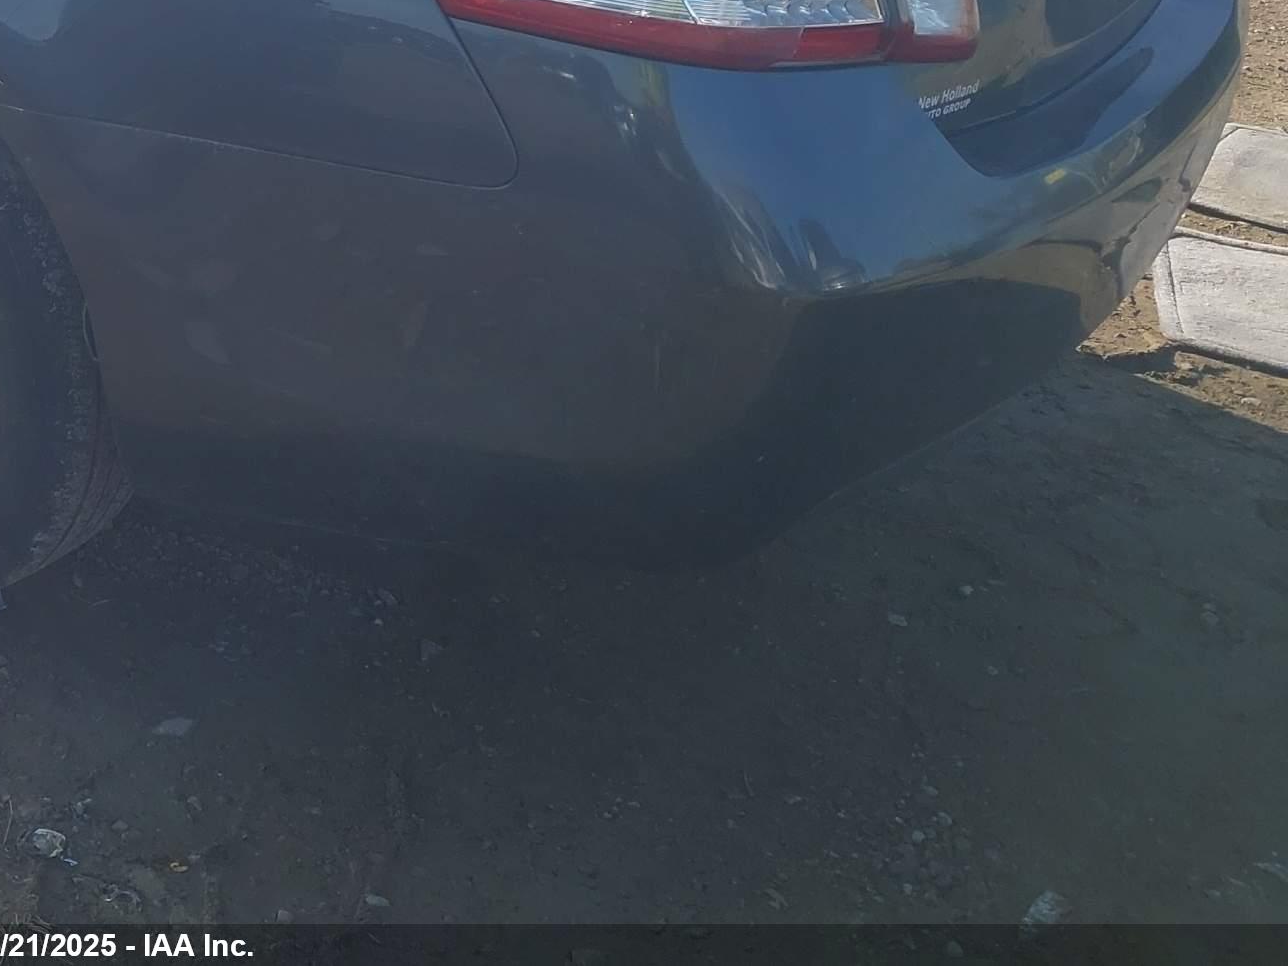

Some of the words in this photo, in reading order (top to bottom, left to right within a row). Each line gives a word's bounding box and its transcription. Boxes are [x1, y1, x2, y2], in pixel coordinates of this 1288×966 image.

[918, 94, 941, 110] New
[941, 79, 981, 104] Holland
[943, 98, 972, 115] GROUP
